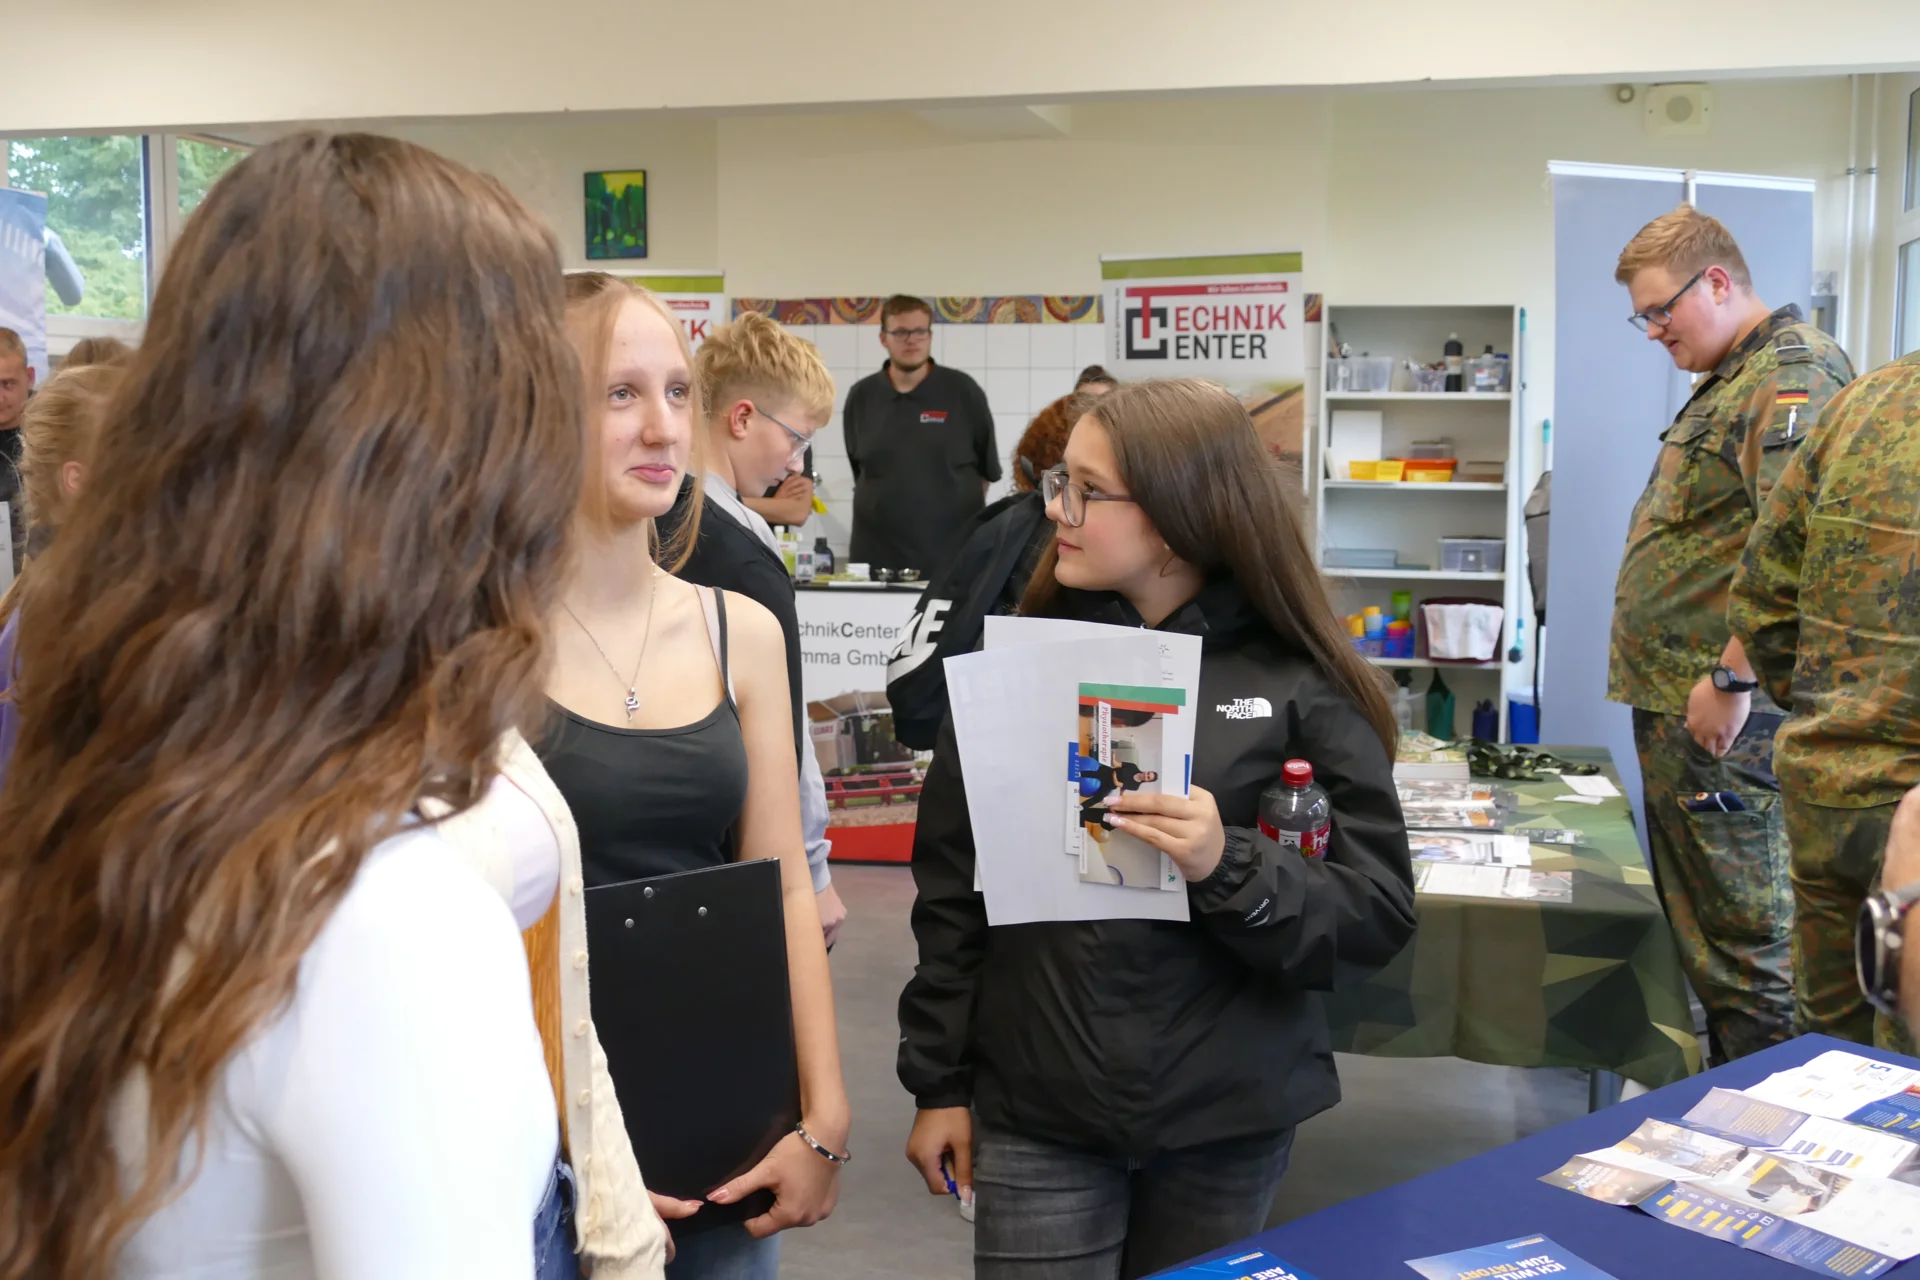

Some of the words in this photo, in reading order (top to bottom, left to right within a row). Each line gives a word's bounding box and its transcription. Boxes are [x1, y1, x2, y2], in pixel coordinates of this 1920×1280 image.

[800, 622, 901, 640] chnikCenter
[801, 651, 841, 665] mma
[847, 650, 890, 666] Gmb
[1216, 704, 1253, 712] NORTH
[1233, 698, 1253, 706] THE
[1100, 706, 1109, 763] Physiotherapie
[1515, 1255, 1555, 1268] ZUM
[1536, 1262, 1566, 1275] ICH
[1457, 1263, 1520, 1280] TATORT
